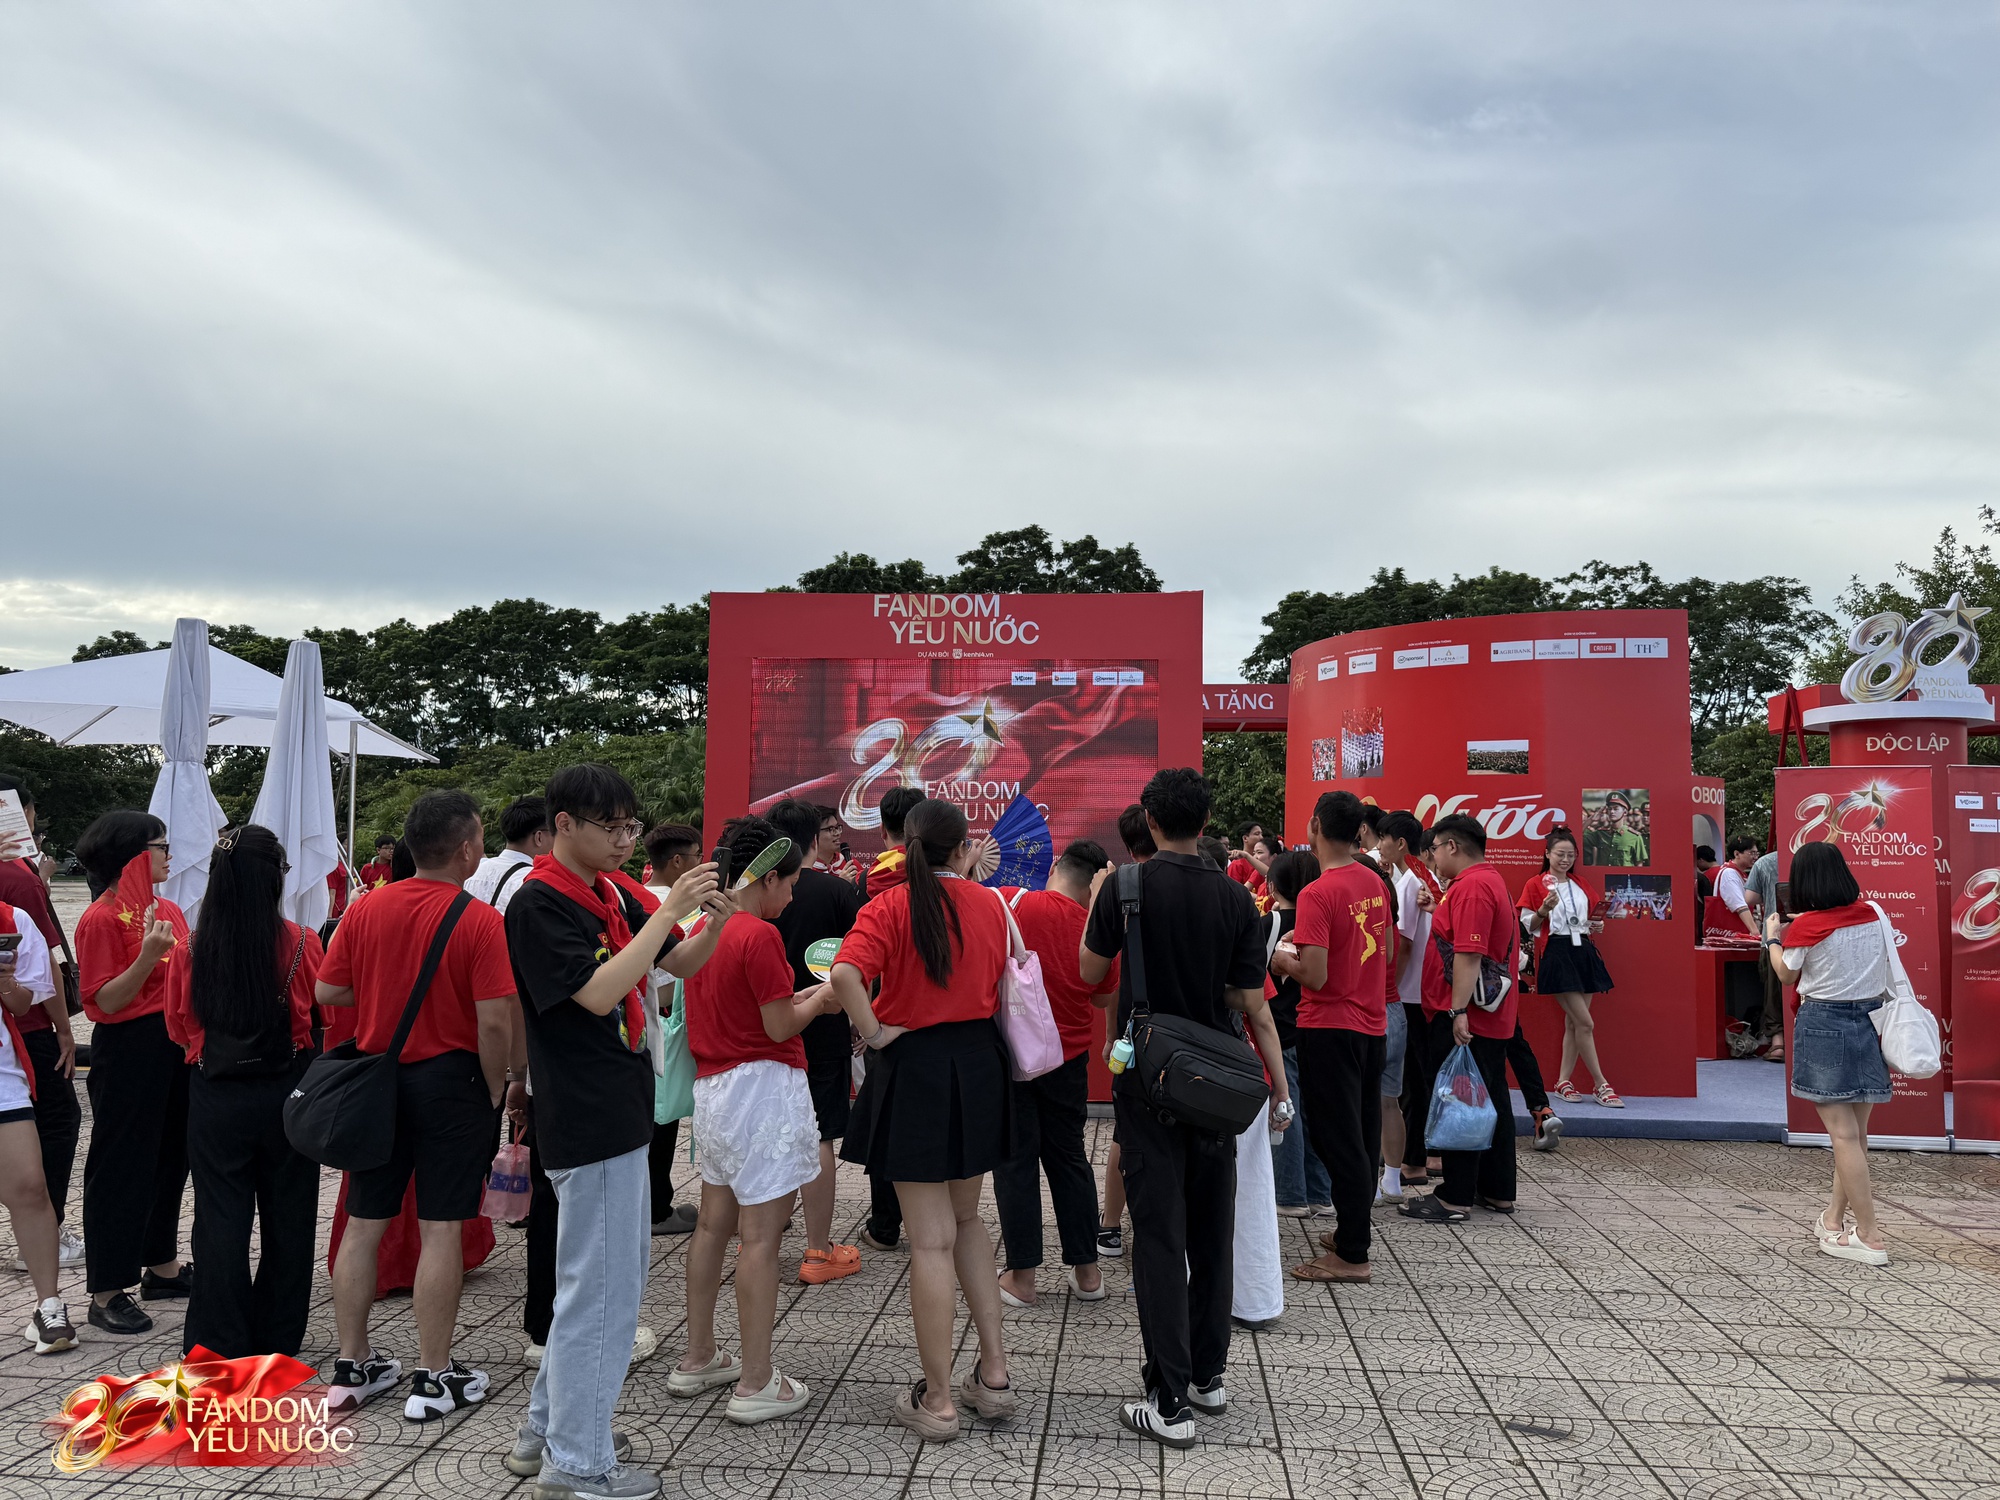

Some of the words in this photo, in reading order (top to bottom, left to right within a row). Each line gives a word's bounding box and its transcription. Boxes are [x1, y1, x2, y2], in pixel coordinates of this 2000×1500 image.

[874, 594, 1000, 618] FANDOM
[889, 613, 946, 644] YÊU
[953, 614, 1040, 645] NƯỚC
[928, 650, 938, 658] ÁN
[1635, 643, 1652, 654] TH
[1214, 688, 1274, 714] TẶNG
[1866, 732, 1913, 755] ĐỘC
[1916, 732, 1950, 755] LẬP
[925, 781, 1020, 800] FANDOM
[1843, 832, 1908, 844] FANDOM
[1852, 841, 1881, 856] YÊU
[1883, 841, 1928, 856] NƯỚC
[1866, 889, 1886, 899] Yêu
[1888, 890, 1916, 899] nước
[1957, 868, 2000, 941] 8
